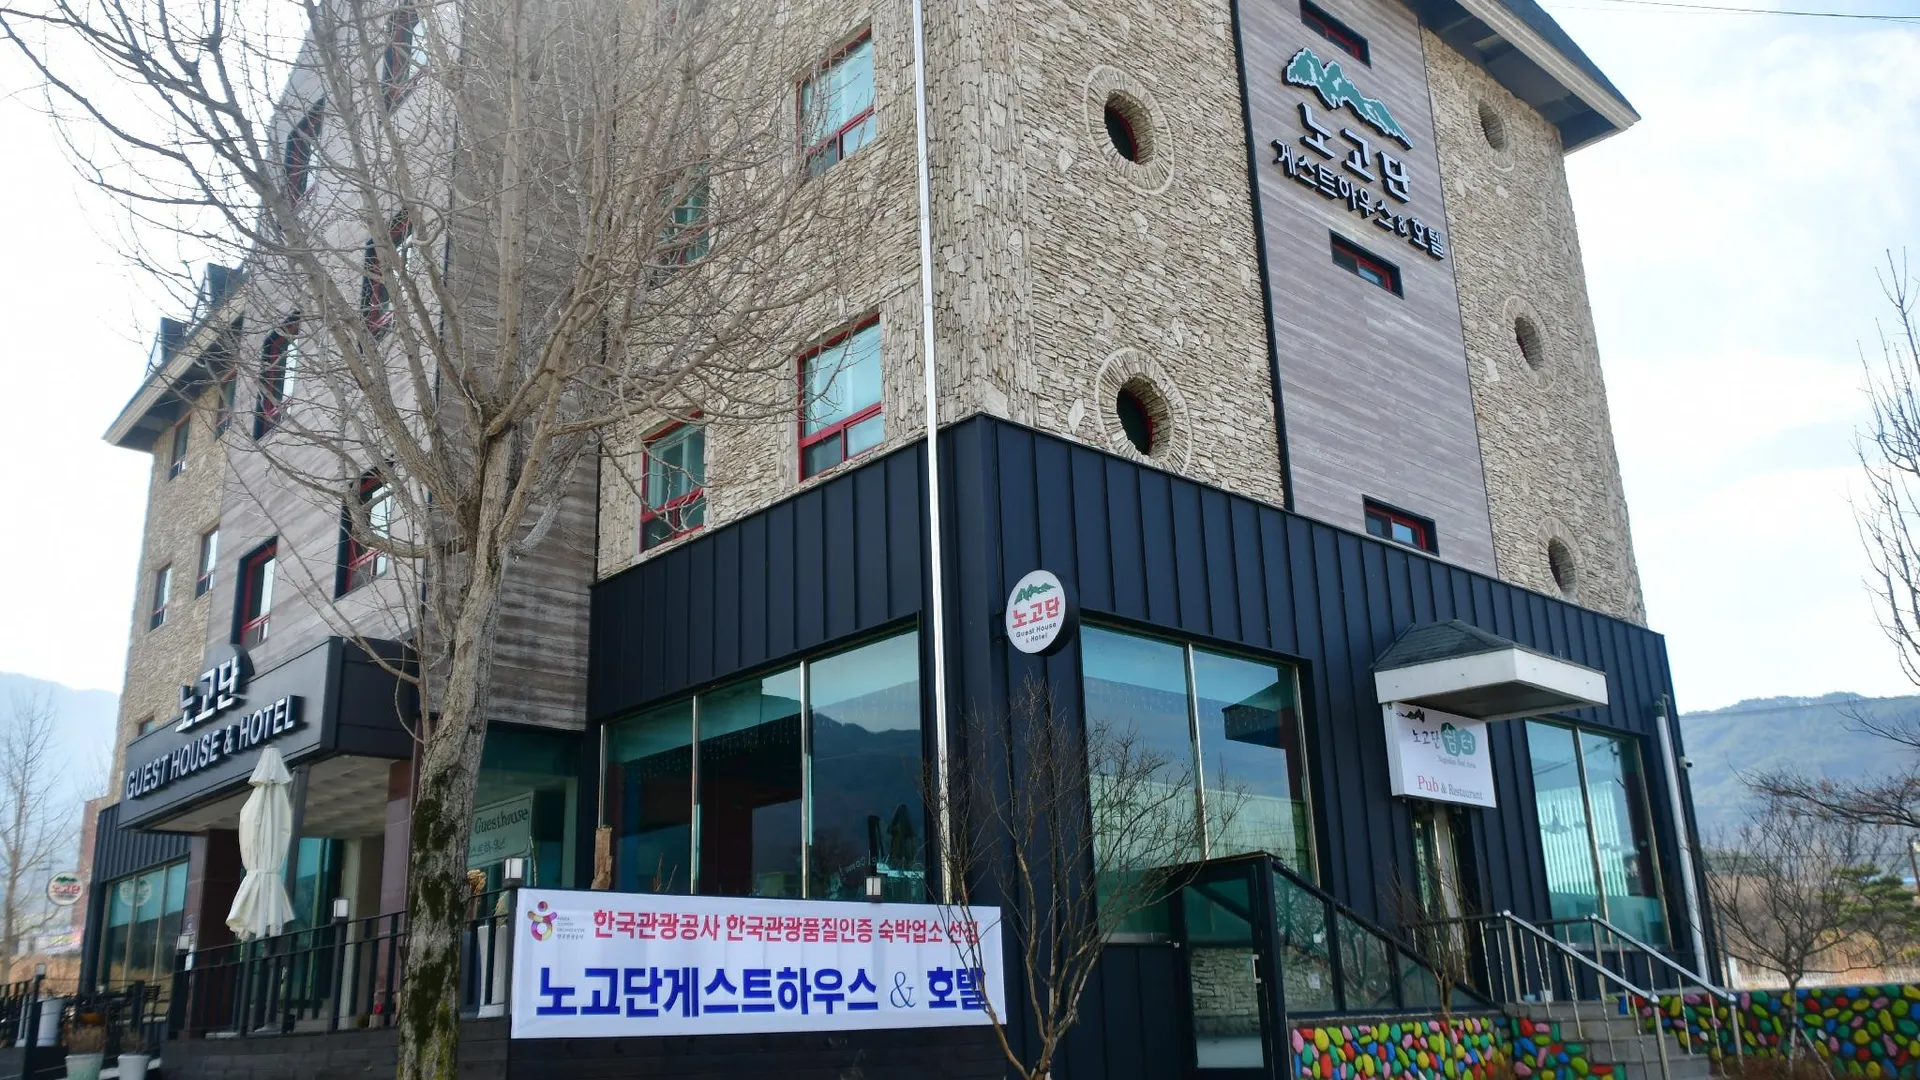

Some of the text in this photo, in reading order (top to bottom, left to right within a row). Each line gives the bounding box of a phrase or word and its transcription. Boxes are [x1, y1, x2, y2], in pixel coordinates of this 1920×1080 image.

[1297, 102, 1411, 203] 노고단
[1012, 596, 1060, 628] 노고단
[1016, 622, 1057, 638] Guest House
[1031, 632, 1048, 642] Hotel
[175, 655, 241, 732] 노고단
[126, 695, 297, 800] GUEST HOUSE & HOTEL
[1412, 728, 1440, 749] 노고단
[1417, 775, 1483, 800] Pub & Restaurant
[593, 909, 721, 942] 한국관광공사
[726, 913, 873, 944] 한국관광품질인증
[878, 919, 943, 944] 숙박업소
[536, 967, 986, 1018] 노고단게스트하우스 & 호텔
